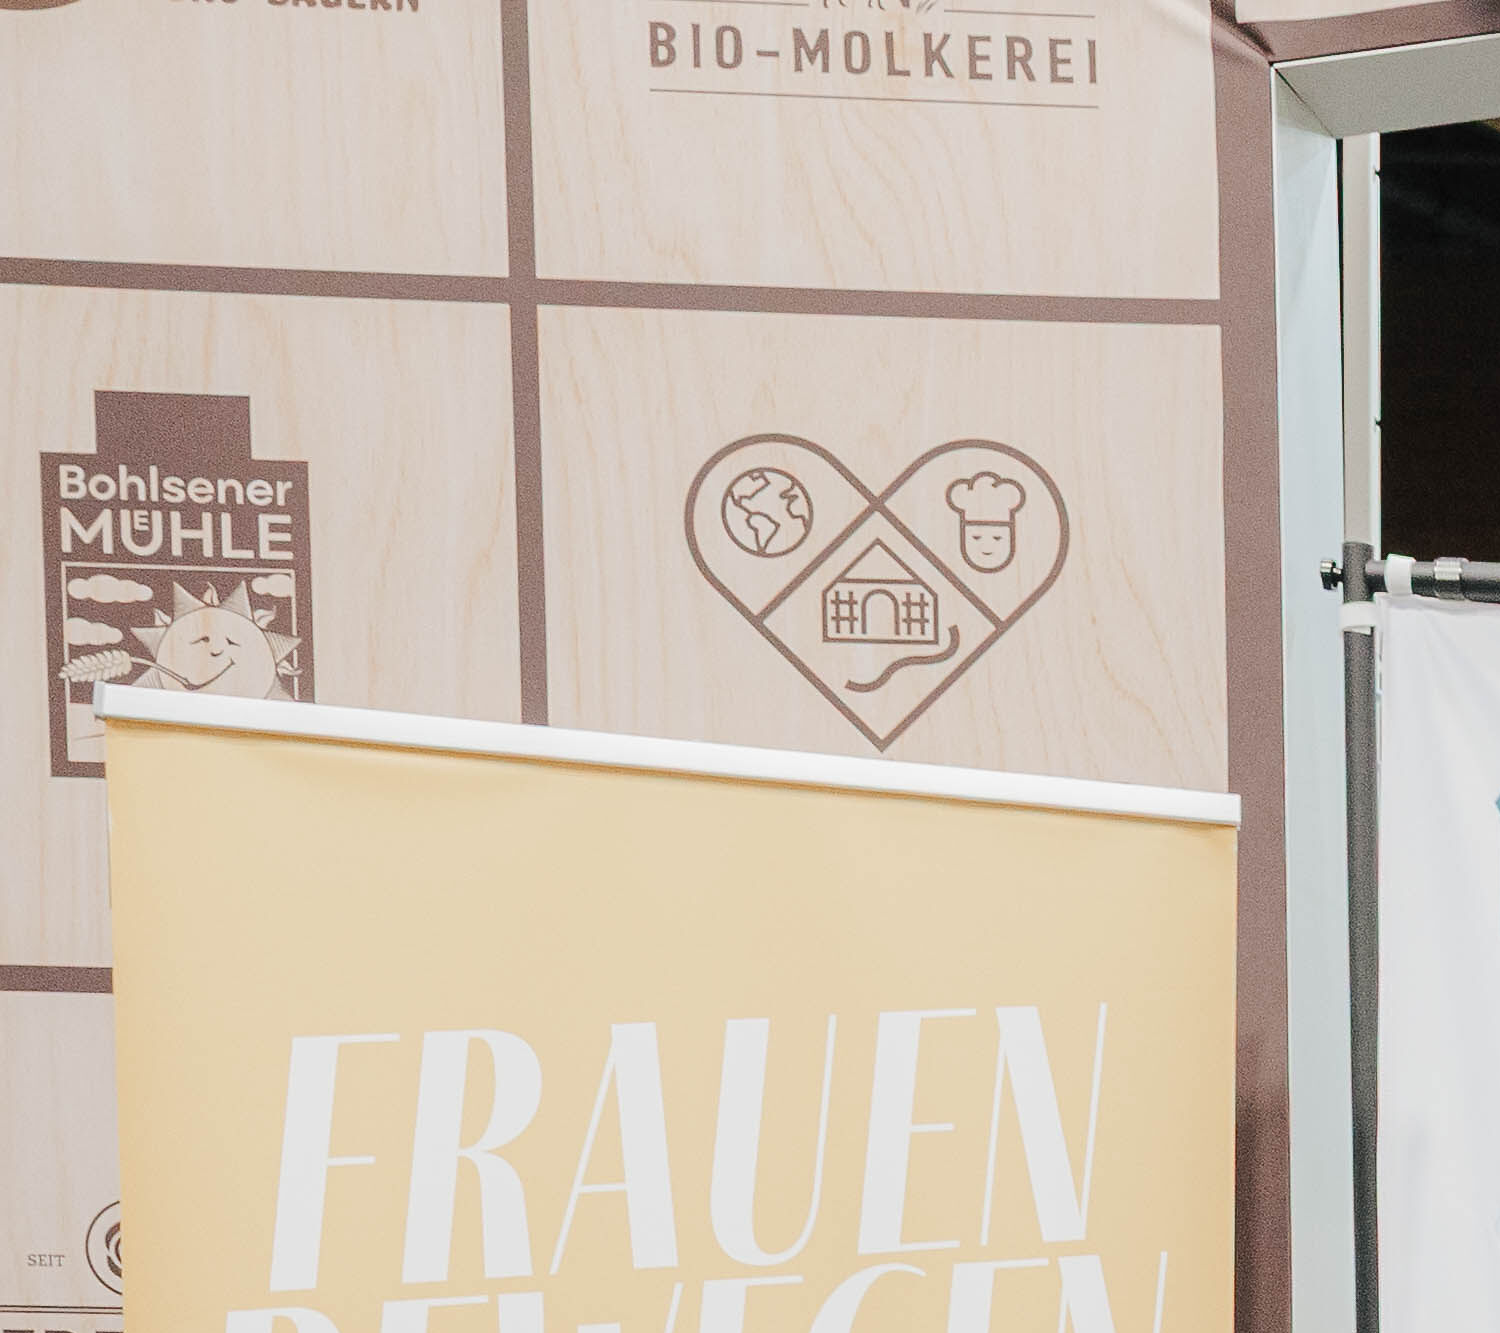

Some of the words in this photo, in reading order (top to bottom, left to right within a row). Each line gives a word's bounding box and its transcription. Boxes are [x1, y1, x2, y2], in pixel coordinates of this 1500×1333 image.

[649, 21, 1098, 84] BIO-MOLKEREI
[59, 464, 292, 506] Bohlsener
[269, 1001, 1108, 1293] FRAUEN
[27, 1253, 65, 1267] SEIT
